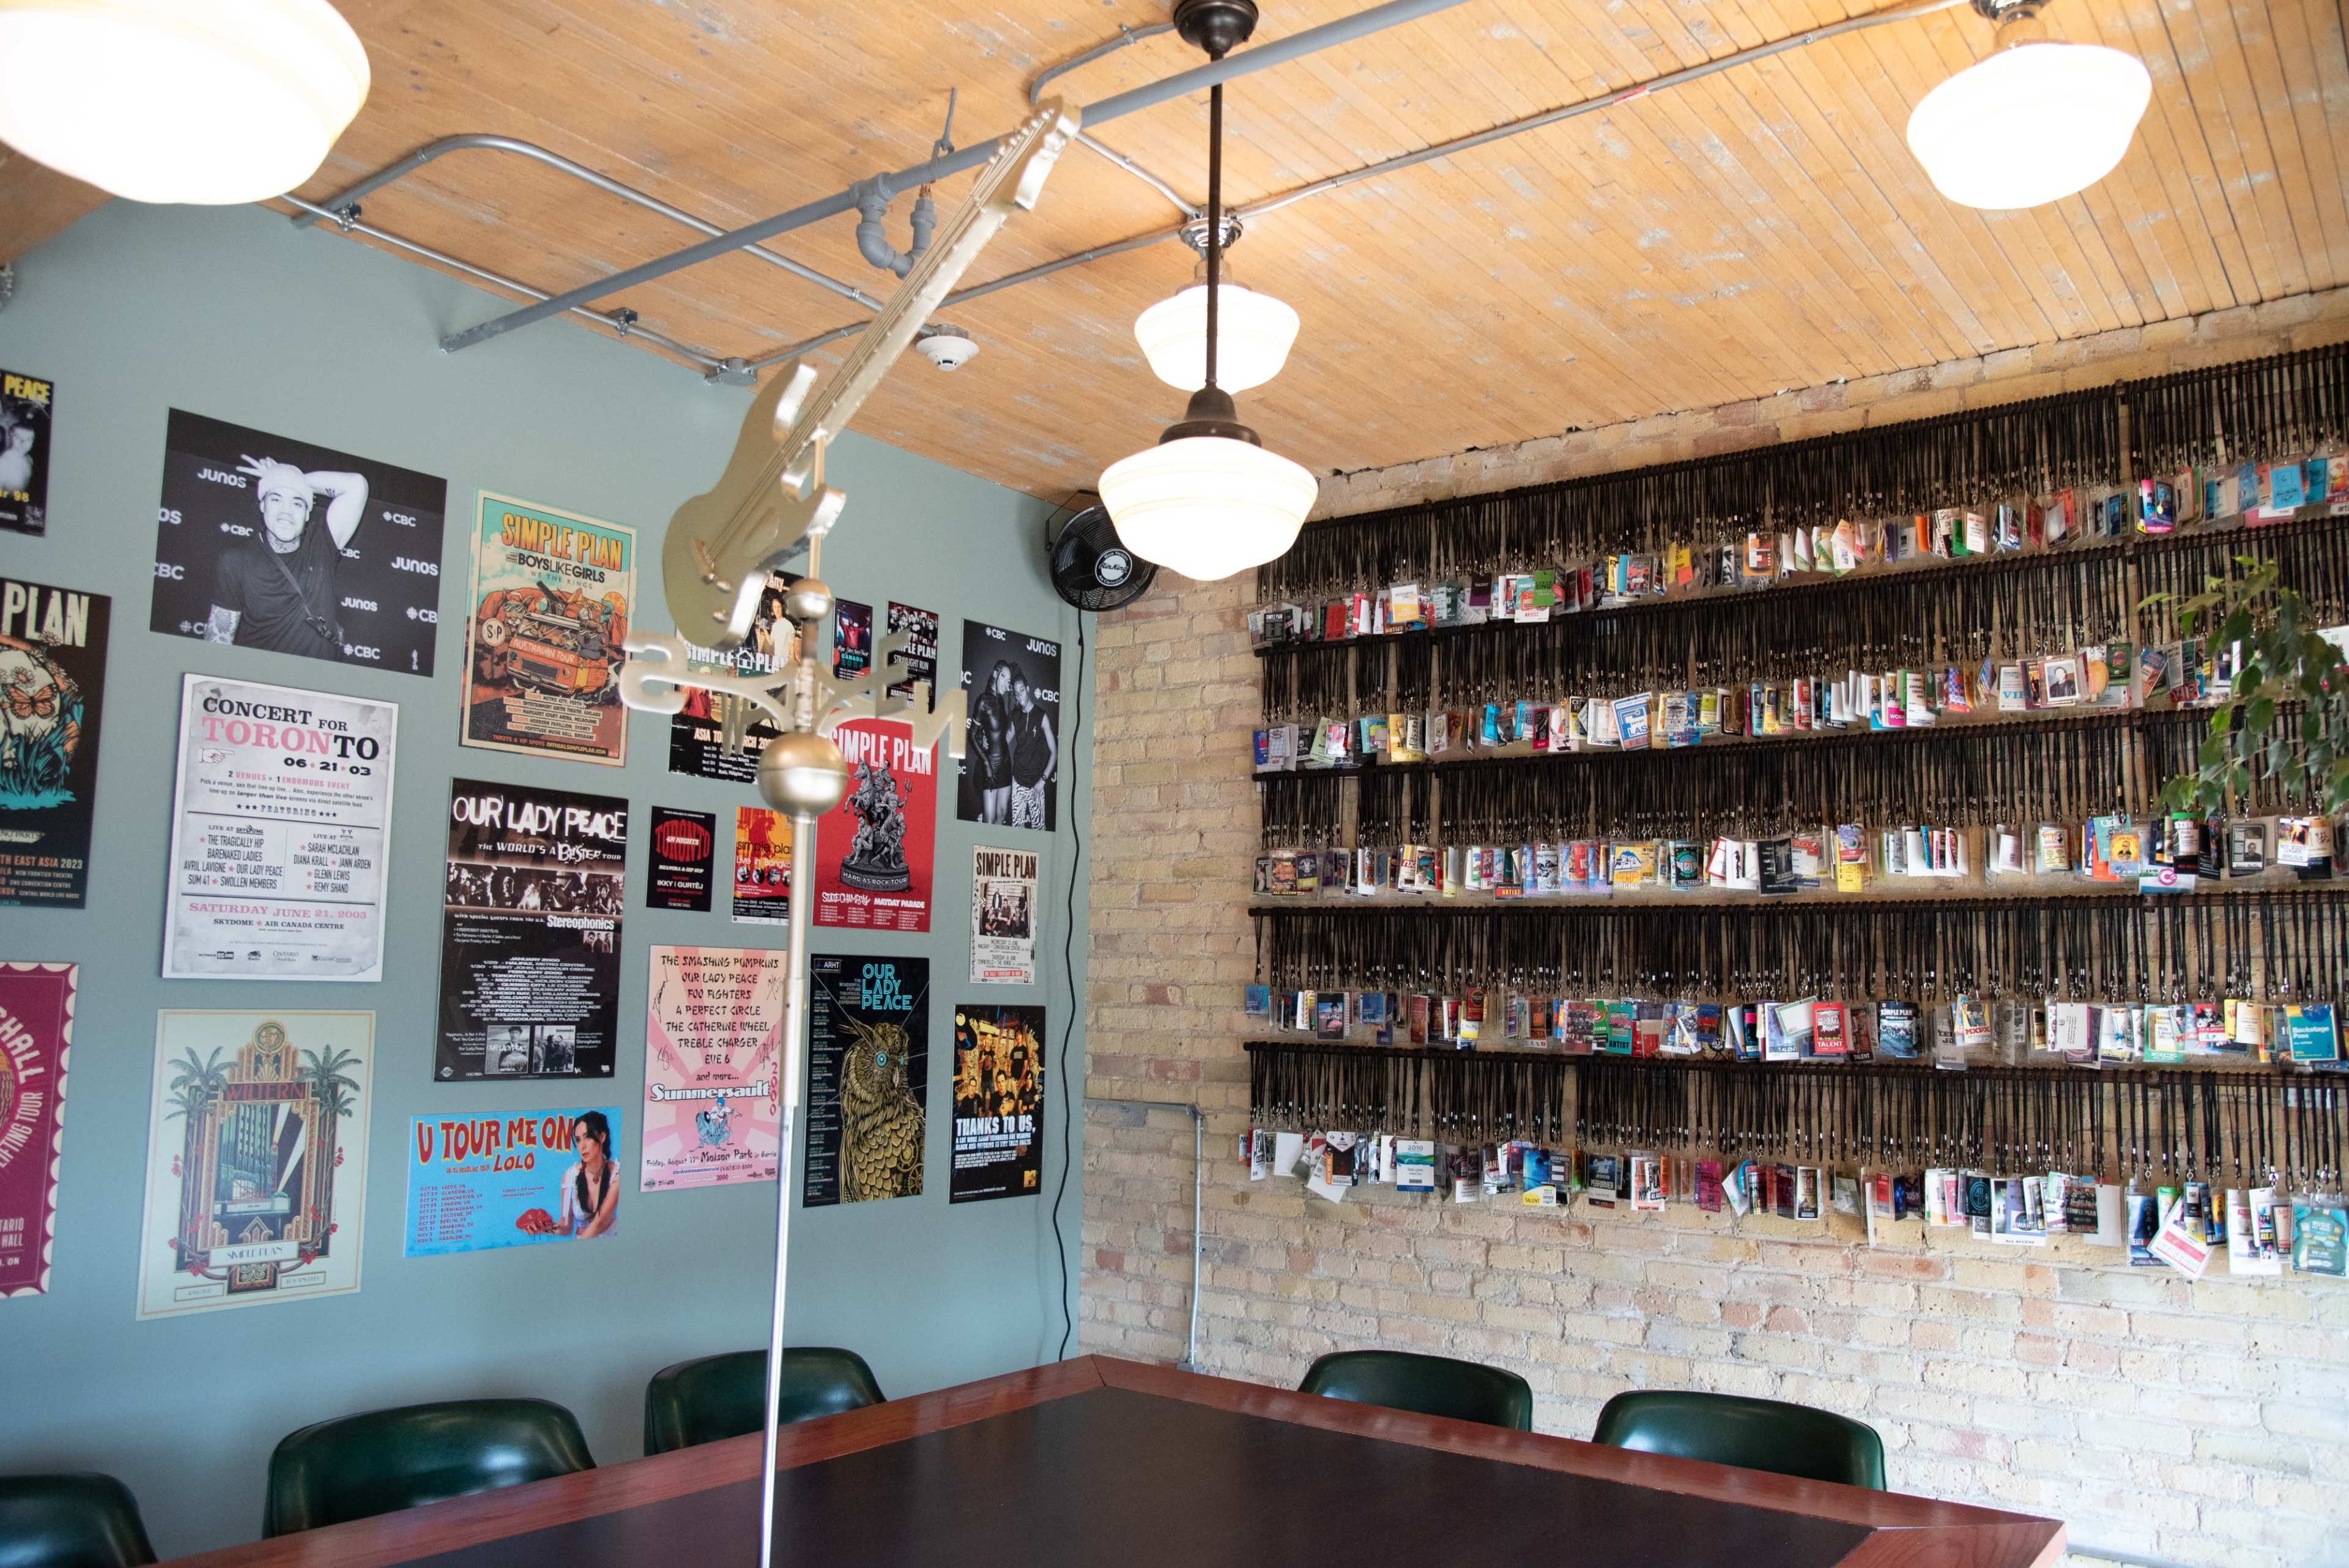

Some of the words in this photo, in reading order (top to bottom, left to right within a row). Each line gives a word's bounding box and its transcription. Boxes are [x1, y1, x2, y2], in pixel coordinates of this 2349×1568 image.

[4, 374, 50, 399] PEACE
[197, 468, 247, 488] JUNOS
[13, 490, 29, 502] 98
[393, 514, 416, 527] CBC
[231, 524, 253, 537] CBC
[501, 513, 573, 560] SIMPLE
[577, 530, 622, 572] PLAN
[392, 557, 439, 576] JUNOS
[567, 579, 593, 589] KINGS
[341, 597, 377, 611] JUNOS
[1, 582, 90, 647] PLAN
[992, 628, 1006, 641] CBC
[354, 645, 380, 660] CBC
[917, 645, 936, 660] PLAN
[1026, 639, 1056, 657] JUNOS
[557, 651, 575, 664] TOUR
[841, 653, 863, 663] CANADA
[919, 660, 929, 671] RUN
[1042, 689, 1059, 702] CBC
[2174, 684, 2196, 699] VIP
[202, 697, 312, 724] CONCERT
[318, 719, 347, 732] FOR
[202, 716, 379, 760] TORONTO
[694, 727, 710, 742] ASIA
[893, 738, 931, 775] PLAN
[284, 757, 307, 768] 06
[319, 762, 337, 771] 21
[349, 766, 371, 776] 03
[236, 771, 265, 781] VENUES
[453, 795, 503, 828] OUR
[508, 802, 561, 836] LADY
[565, 808, 626, 843] PEACE
[208, 834, 218, 845] THE
[220, 836, 253, 848] TRAGICALLY
[254, 838, 264, 849] HIP
[676, 837, 699, 845] NIGHTS
[737, 841, 771, 854] simple
[207, 848, 241, 860] BARENAKED
[243, 851, 262, 861] LADIES
[308, 842, 326, 853] SARAH
[327, 844, 360, 856] MCLACHLAN
[496, 842, 546, 855] WORLD'S
[14, 856, 36, 866] EAST
[38, 857, 59, 868] ASIA
[61, 858, 83, 869] 2023
[184, 860, 200, 872] AVRIL
[202, 861, 226, 873] LAVIGNE
[294, 854, 310, 865] DIANA
[311, 856, 328, 866] KRALL
[338, 858, 352, 868] JANN
[354, 859, 371, 869] ARDEN
[976, 852, 1011, 877] SIMPLE
[1014, 856, 1036, 879] PLAN
[236, 863, 248, 874] OUR
[250, 864, 264, 875] LADY
[265, 866, 283, 877] PEACE
[314, 869, 332, 879] GLENN
[333, 870, 351, 880] LEWIS
[188, 874, 201, 885] SUM
[220, 876, 248, 888] SWOLLEN
[249, 879, 278, 890] MEMBERS
[843, 872, 861, 882] HARD
[314, 882, 329, 892] REMY
[331, 883, 349, 893] SHAND
[874, 898, 899, 907] MAYDAY
[900, 900, 925, 908] PARADE
[189, 902, 269, 915] SATURDAY
[273, 908, 311, 918] JUNE
[547, 915, 615, 930] Stereophonics
[661, 956, 679, 966] THE
[682, 956, 730, 968] SMASHING
[734, 957, 779, 968] PUMPKINS
[681, 972, 699, 983] OUR
[703, 973, 727, 983] LADY
[729, 974, 757, 984] PEACE
[863, 964, 895, 979] OUR
[863, 979, 901, 995] LADY
[688, 989, 703, 998] FOO
[707, 989, 751, 999] FIGHTERS
[862, 994, 912, 1011] PEACE
[676, 1006, 682, 1015] A
[686, 1006, 727, 1016] PERFECT
[730, 1006, 760, 1016] CIRCLE
[666, 1022, 684, 1031] THE
[687, 1022, 737, 1031] CATHERINE
[740, 1022, 770, 1031] WHEEL
[677, 1038, 713, 1048] TREBLE
[717, 1038, 757, 1047] CHARGER
[705, 1054, 722, 1064] EVE
[725, 1055, 730, 1064] 6
[696, 1071, 710, 1081] and
[650, 1080, 771, 1102] Summersault
[15, 1092, 43, 1122] TOUR
[956, 1117, 999, 1136] THANKS
[1003, 1116, 1015, 1133] TO
[1019, 1115, 1036, 1133] US,
[417, 1121, 432, 1164] U
[440, 1118, 501, 1161] TOUR
[507, 1117, 538, 1151] ME
[541, 1114, 574, 1153] ON
[700, 1152, 730, 1162] Molson
[734, 1150, 752, 1160] Park
[1591, 1181, 1614, 1190] PERFORMER
[2, 1233, 23, 1247] HALL
